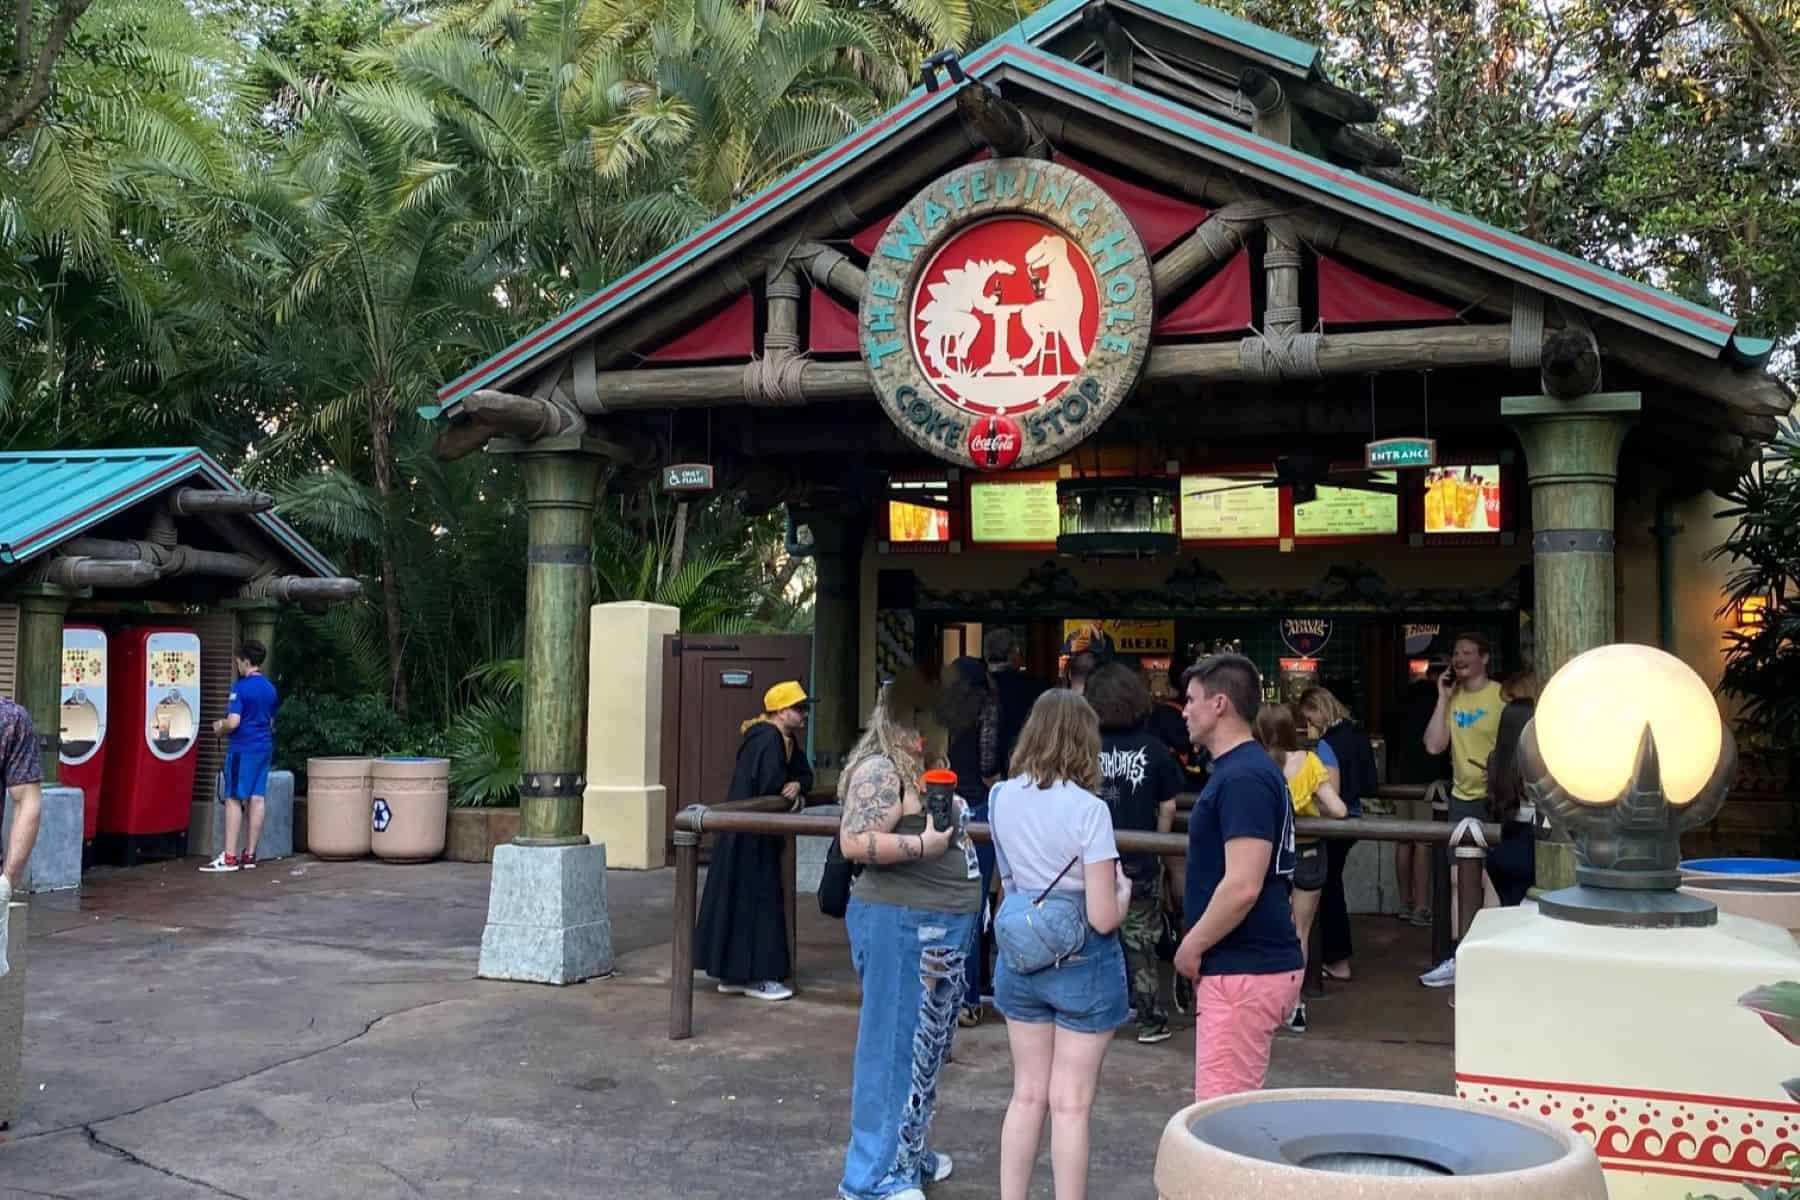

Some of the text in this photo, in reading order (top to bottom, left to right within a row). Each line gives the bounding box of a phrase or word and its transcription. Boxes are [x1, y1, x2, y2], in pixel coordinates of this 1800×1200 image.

[867, 269, 903, 370] THE
[1089, 230, 1137, 355] HOLE
[895, 377, 1102, 449] COKE STOP
[1371, 449, 1429, 461] ENTRANCE
